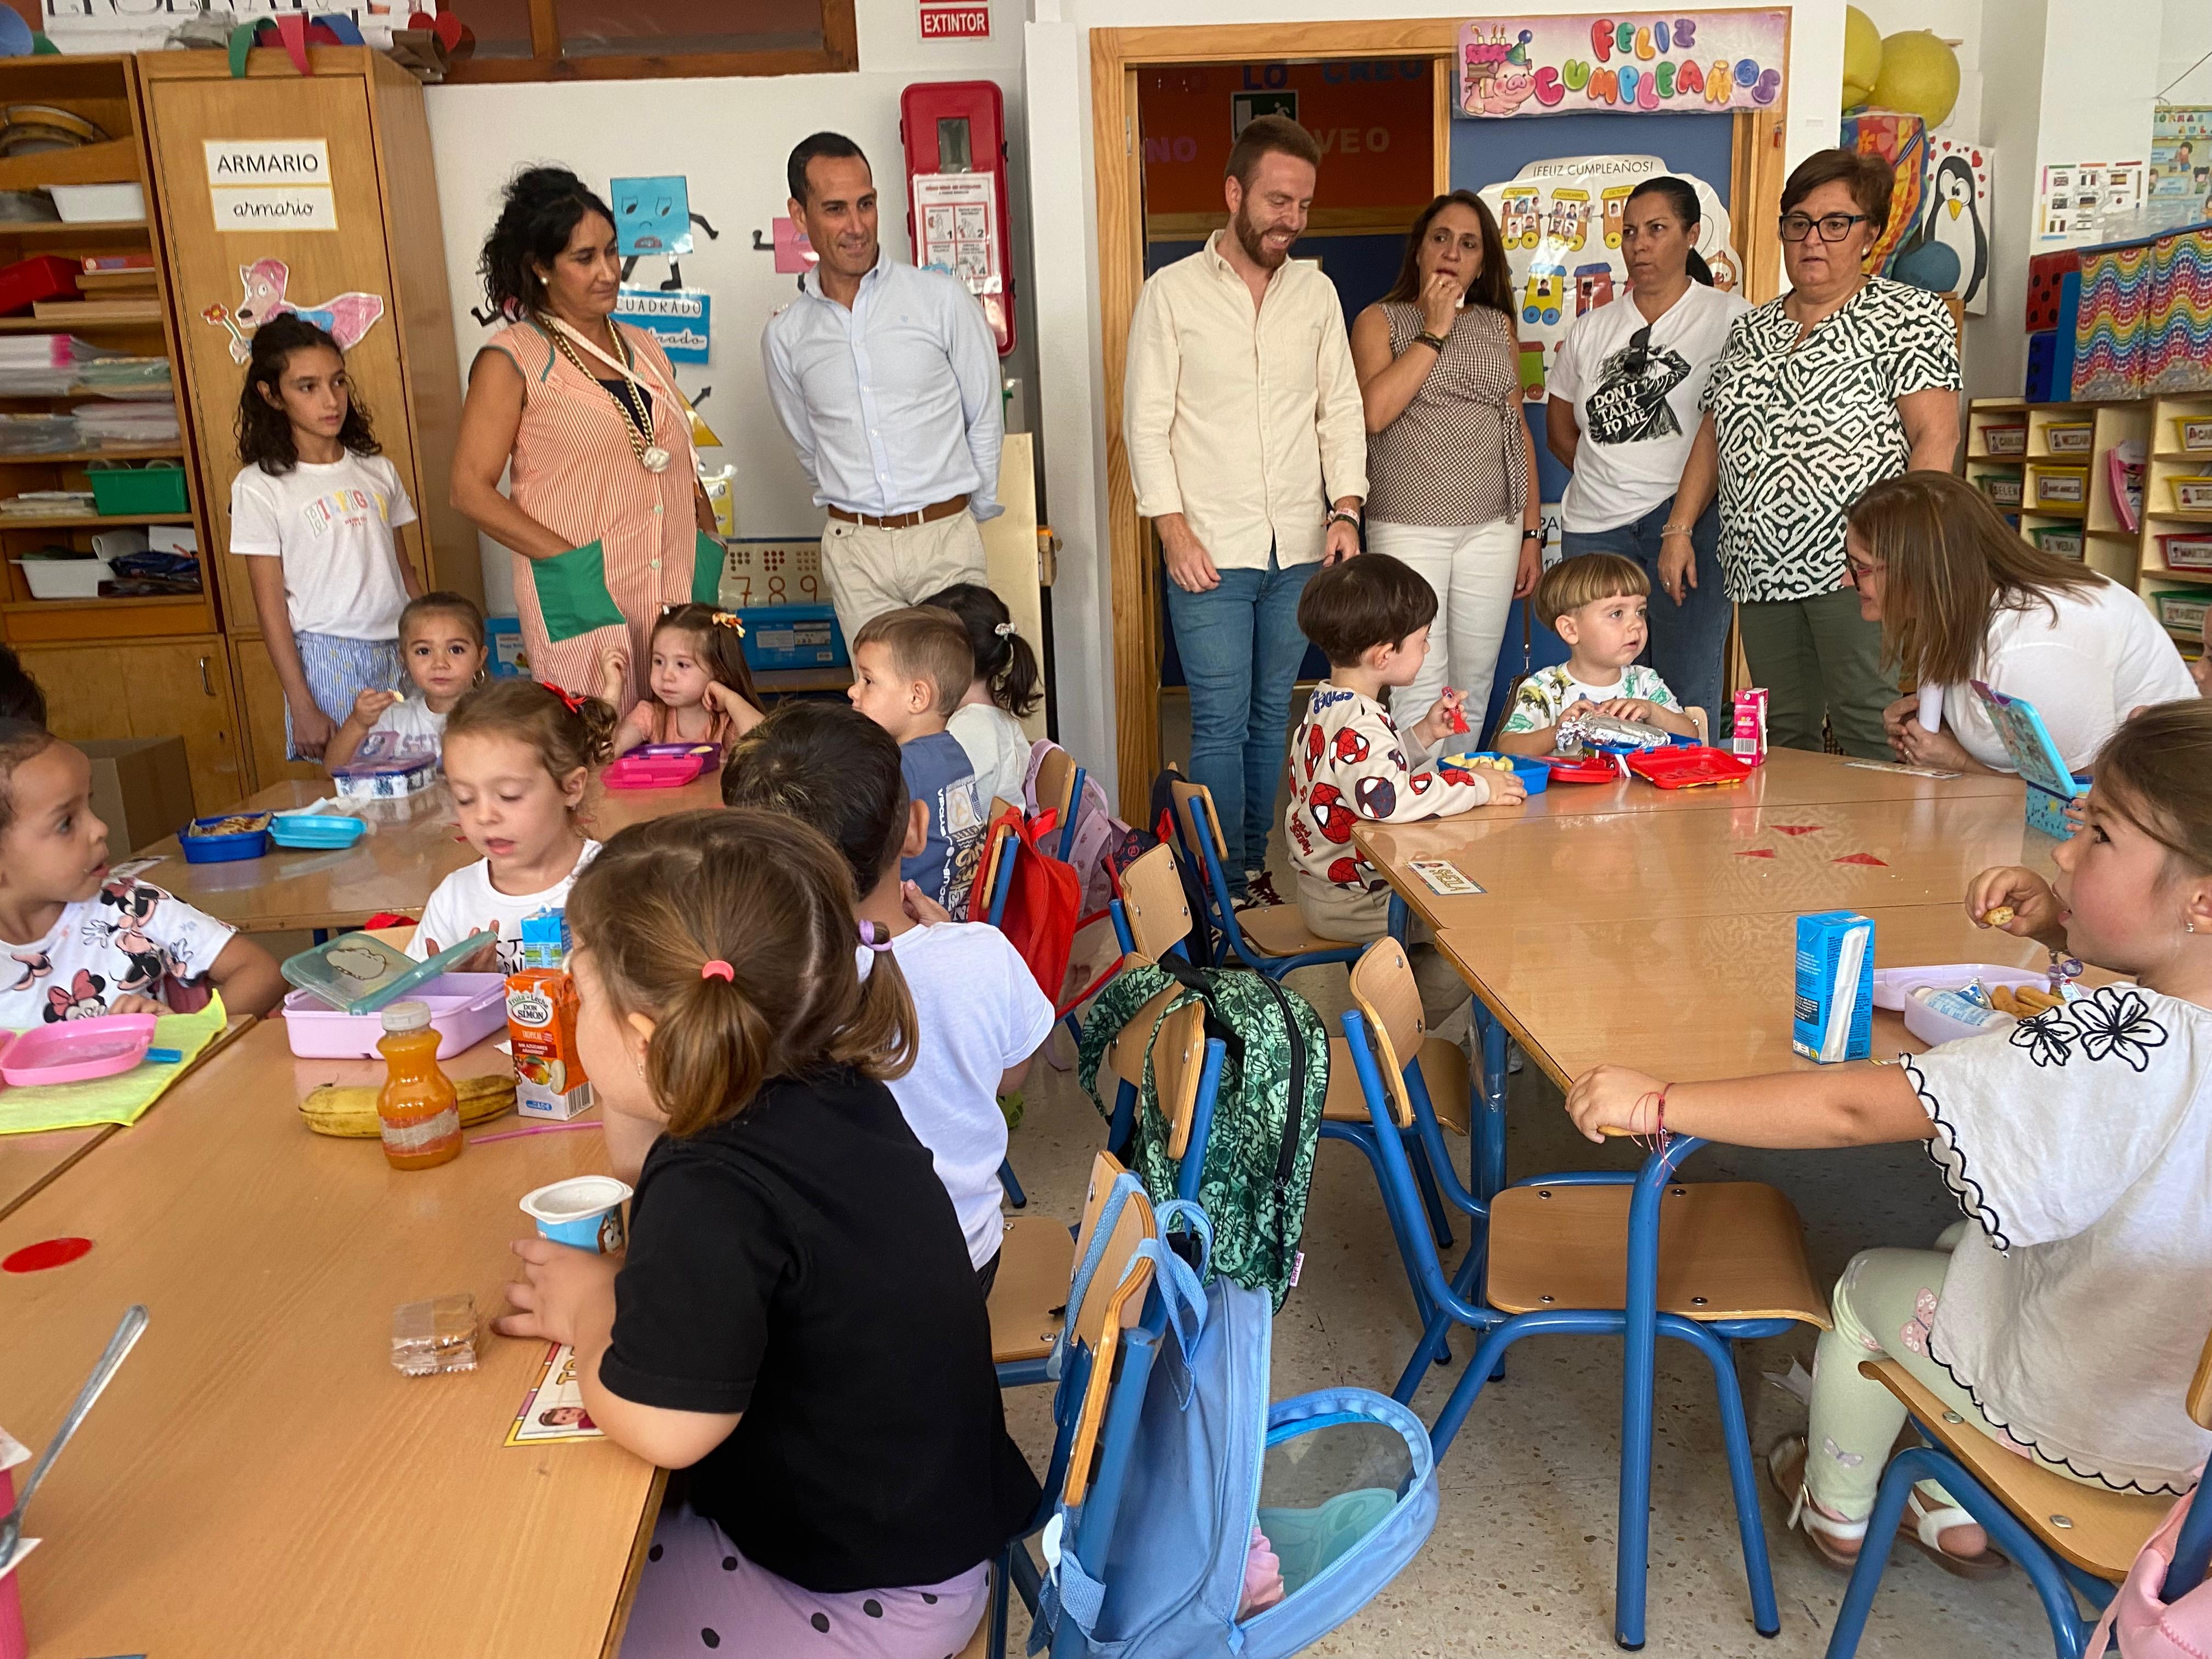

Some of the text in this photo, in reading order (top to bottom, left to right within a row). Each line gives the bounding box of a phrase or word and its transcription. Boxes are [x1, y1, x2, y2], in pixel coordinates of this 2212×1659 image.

[923, 13, 985, 33] EXTINTOR
[1592, 19, 1696, 62] FELIZ
[1243, 64, 1289, 90] LO
[1534, 58, 1780, 109] CUMPLEAÑOS
[1146, 127, 1390, 163] NO VEO
[218, 154, 319, 173] ARMARIO
[1567, 159, 1653, 176] CUMPLEAÑOS!
[233, 201, 314, 217] armario
[947, 229, 984, 239] 1 2
[1598, 397, 1641, 422] TALK
[1602, 409, 1648, 436] TO ME
[731, 575, 817, 607] 7 8 9
[1429, 868, 1471, 891] SHEILA
[508, 994, 549, 1009] Fruta Leche
[517, 1009, 544, 1020] SIMON
[1291, 1257, 1301, 1284] safta
